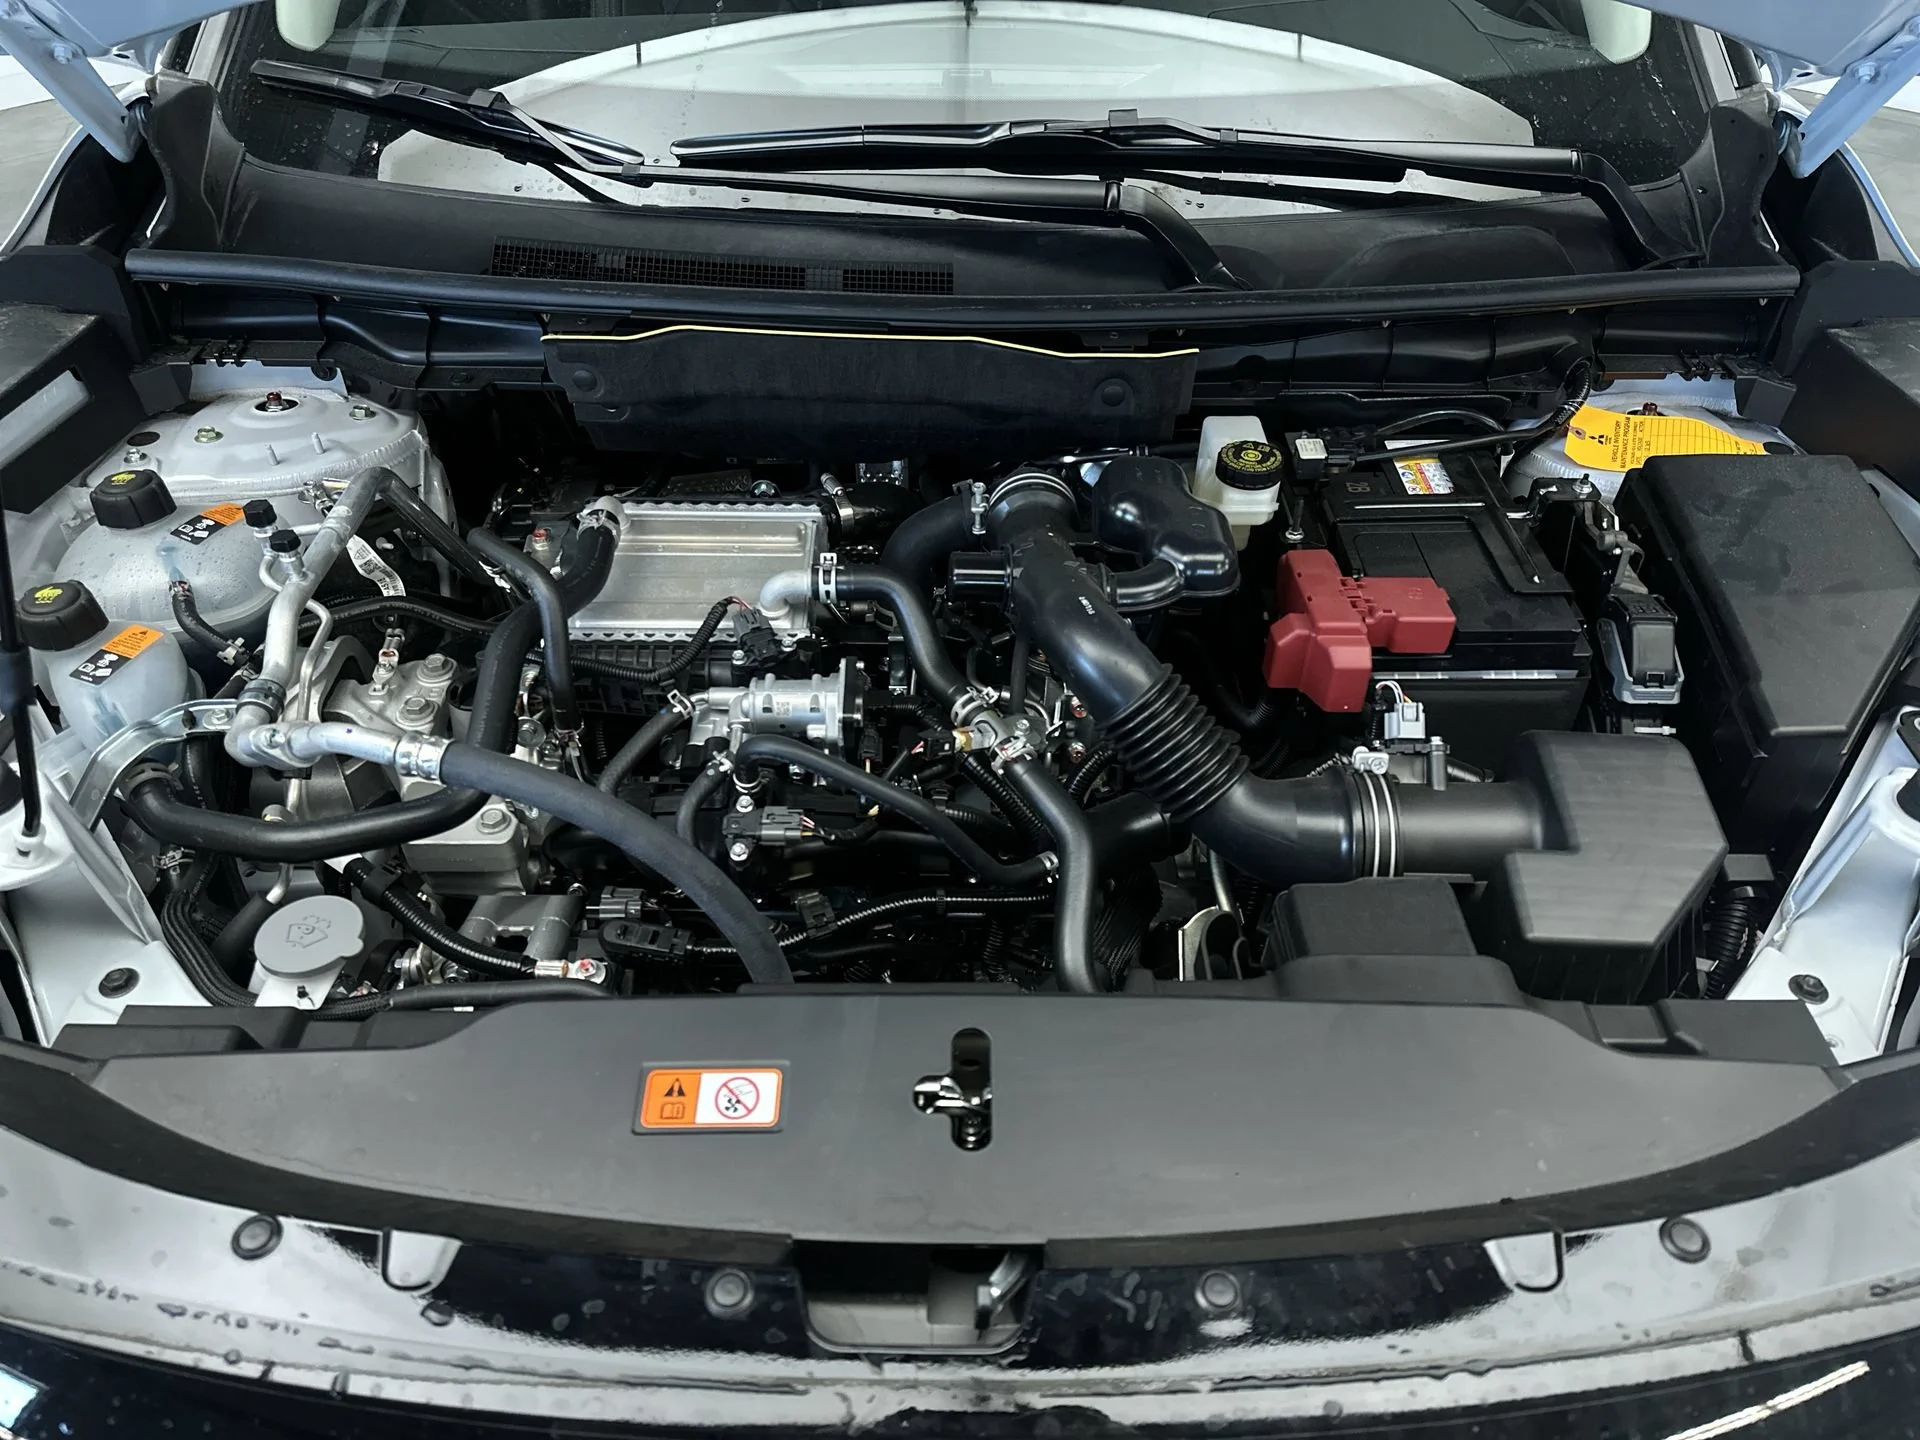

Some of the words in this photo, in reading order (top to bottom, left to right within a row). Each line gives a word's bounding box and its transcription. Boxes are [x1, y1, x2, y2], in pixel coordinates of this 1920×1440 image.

[1613, 420, 1621, 444] INVENTORY
[1612, 445, 1620, 462] VEHICLE
[1620, 438, 1628, 468] MAINTENANCE
